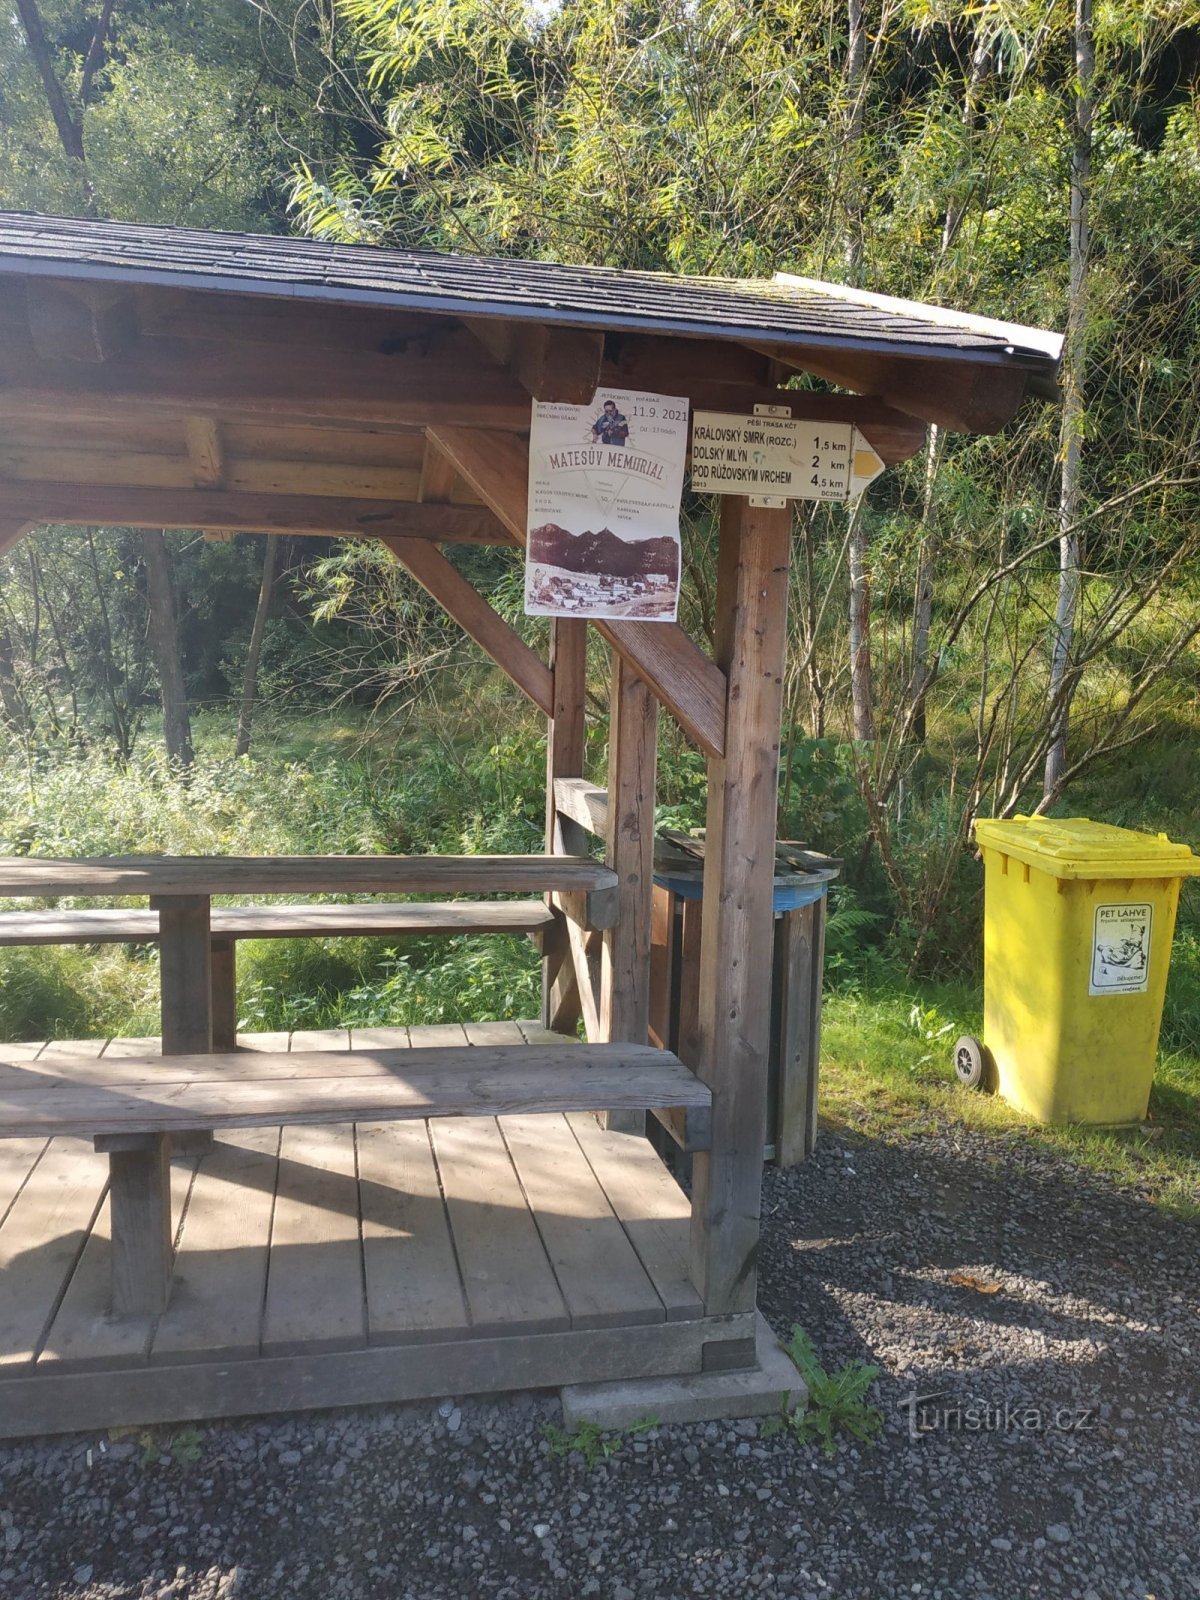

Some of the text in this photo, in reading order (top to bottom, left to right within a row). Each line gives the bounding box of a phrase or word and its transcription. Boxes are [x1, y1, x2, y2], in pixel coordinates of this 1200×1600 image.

[662, 408, 687, 422] 2021
[694, 424, 797, 448] KRÁLOVSKÝ SMRK (ROZC.)
[813, 436, 846, 451] 1,5 km
[693, 445, 748, 462] DOLSKÝ MLÝN
[812, 455, 845, 470] 2 km
[693, 464, 792, 484] POD RŮŽOVSKÝM VRCHEM
[810, 474, 844, 488] 4,5 km
[1100, 910, 1115, 918] PET
